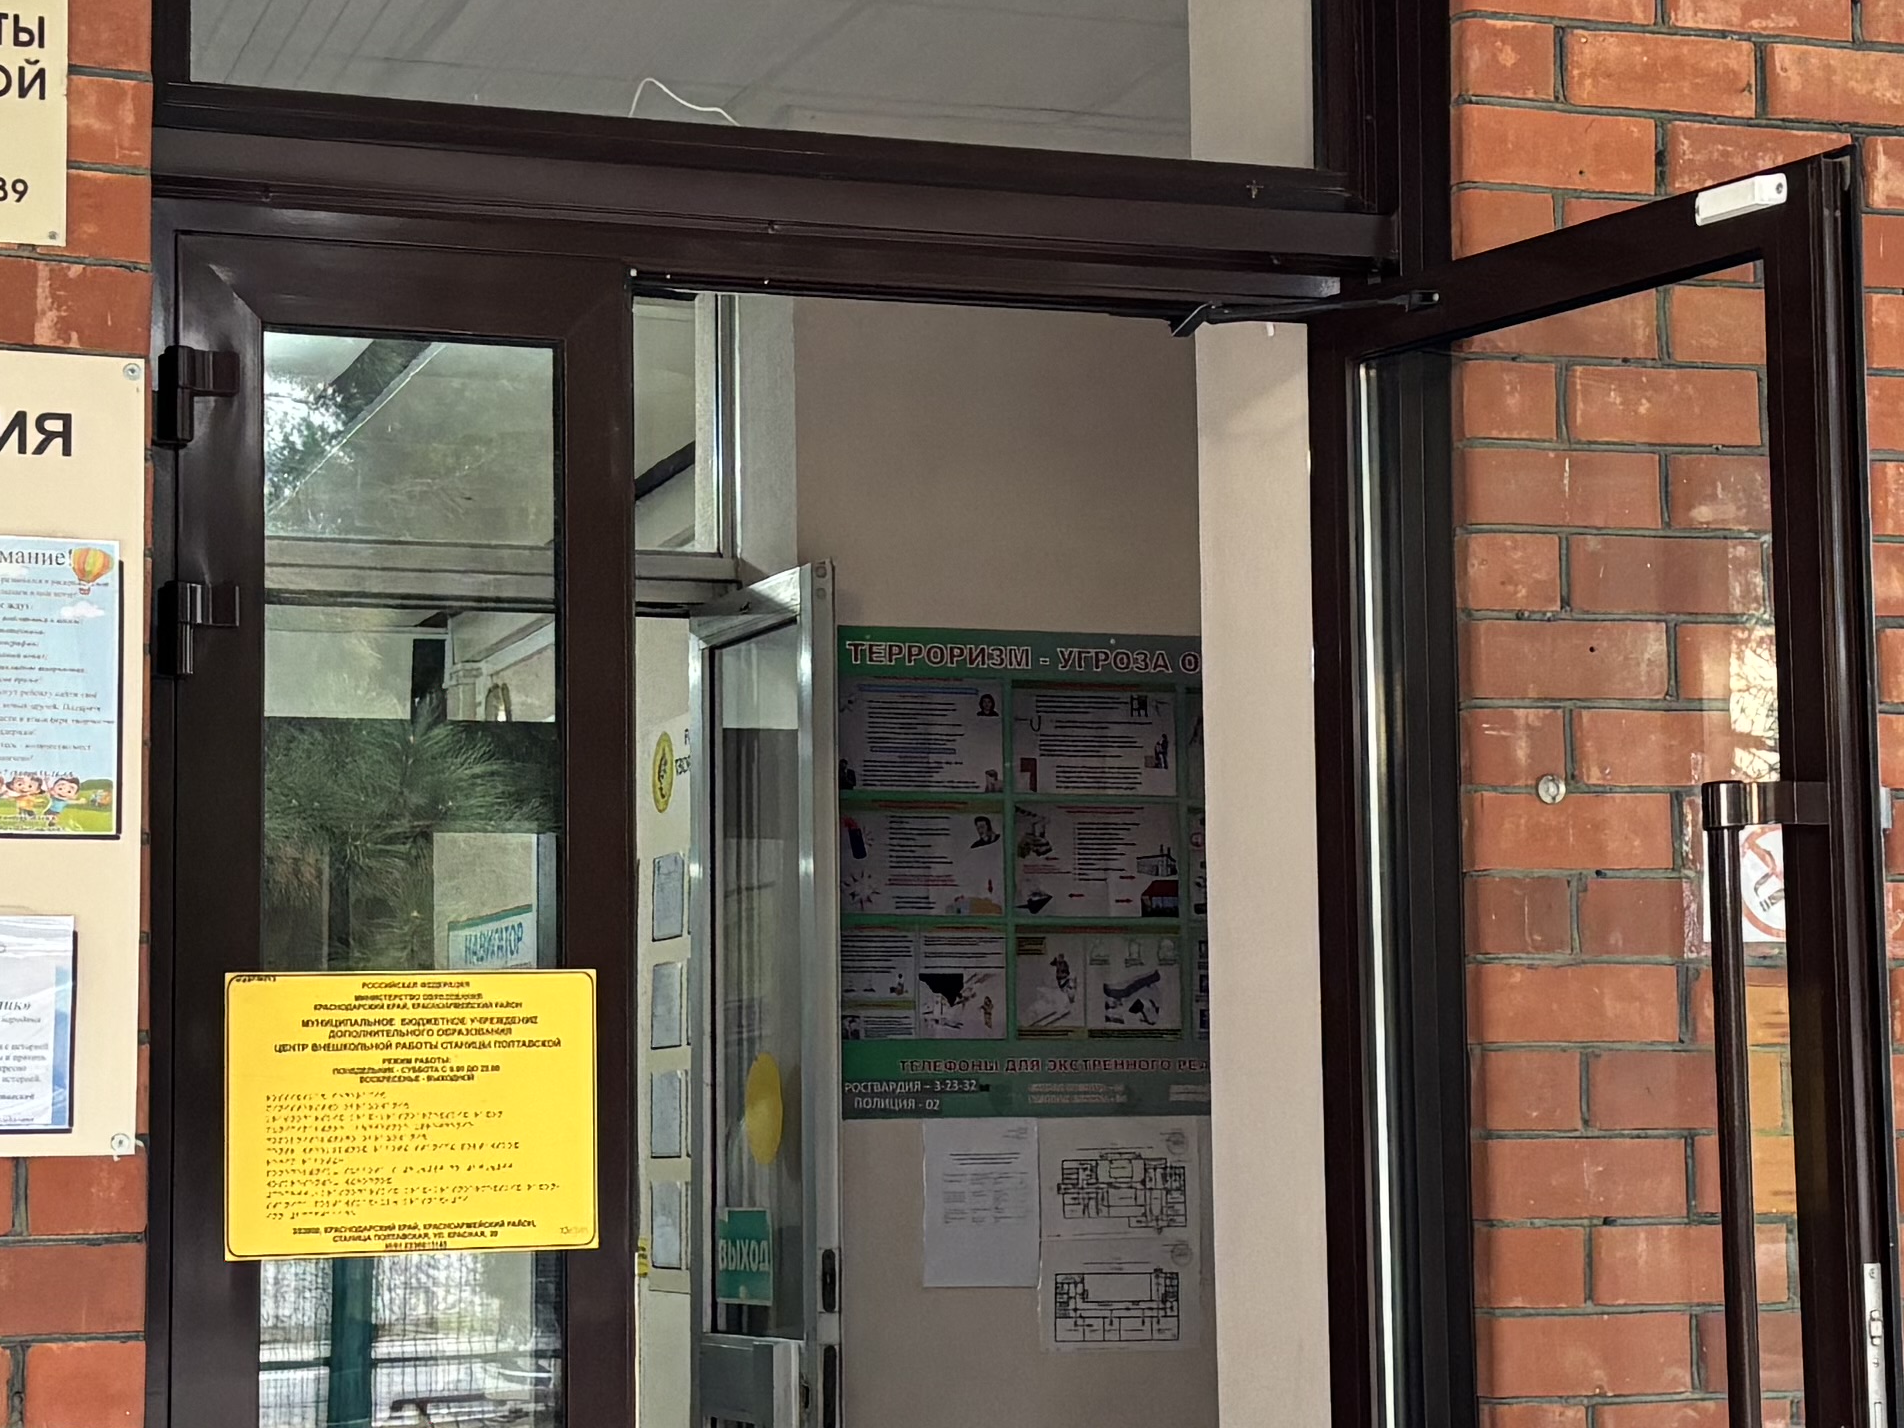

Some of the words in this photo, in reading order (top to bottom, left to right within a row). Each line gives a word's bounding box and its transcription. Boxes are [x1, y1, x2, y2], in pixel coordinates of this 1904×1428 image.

[846, 641, 1031, 670] ТЕРРОРИЗМ
[1057, 647, 1172, 673] УГРОЗА
[899, 1059, 999, 1073] ТЕЛЕФОНЫ
[1004, 1059, 1041, 1073] ДЛЯ
[1045, 1058, 1171, 1072] ЭКСТРЕННОГО
[845, 1081, 921, 1094] РОСГВАРДИЯ
[934, 1080, 977, 1092] 3-23-32
[854, 1098, 915, 1111] ПОЛИЦИЯ
[926, 1098, 940, 1110] 02
[719, 1240, 770, 1271] ВЫХОД
